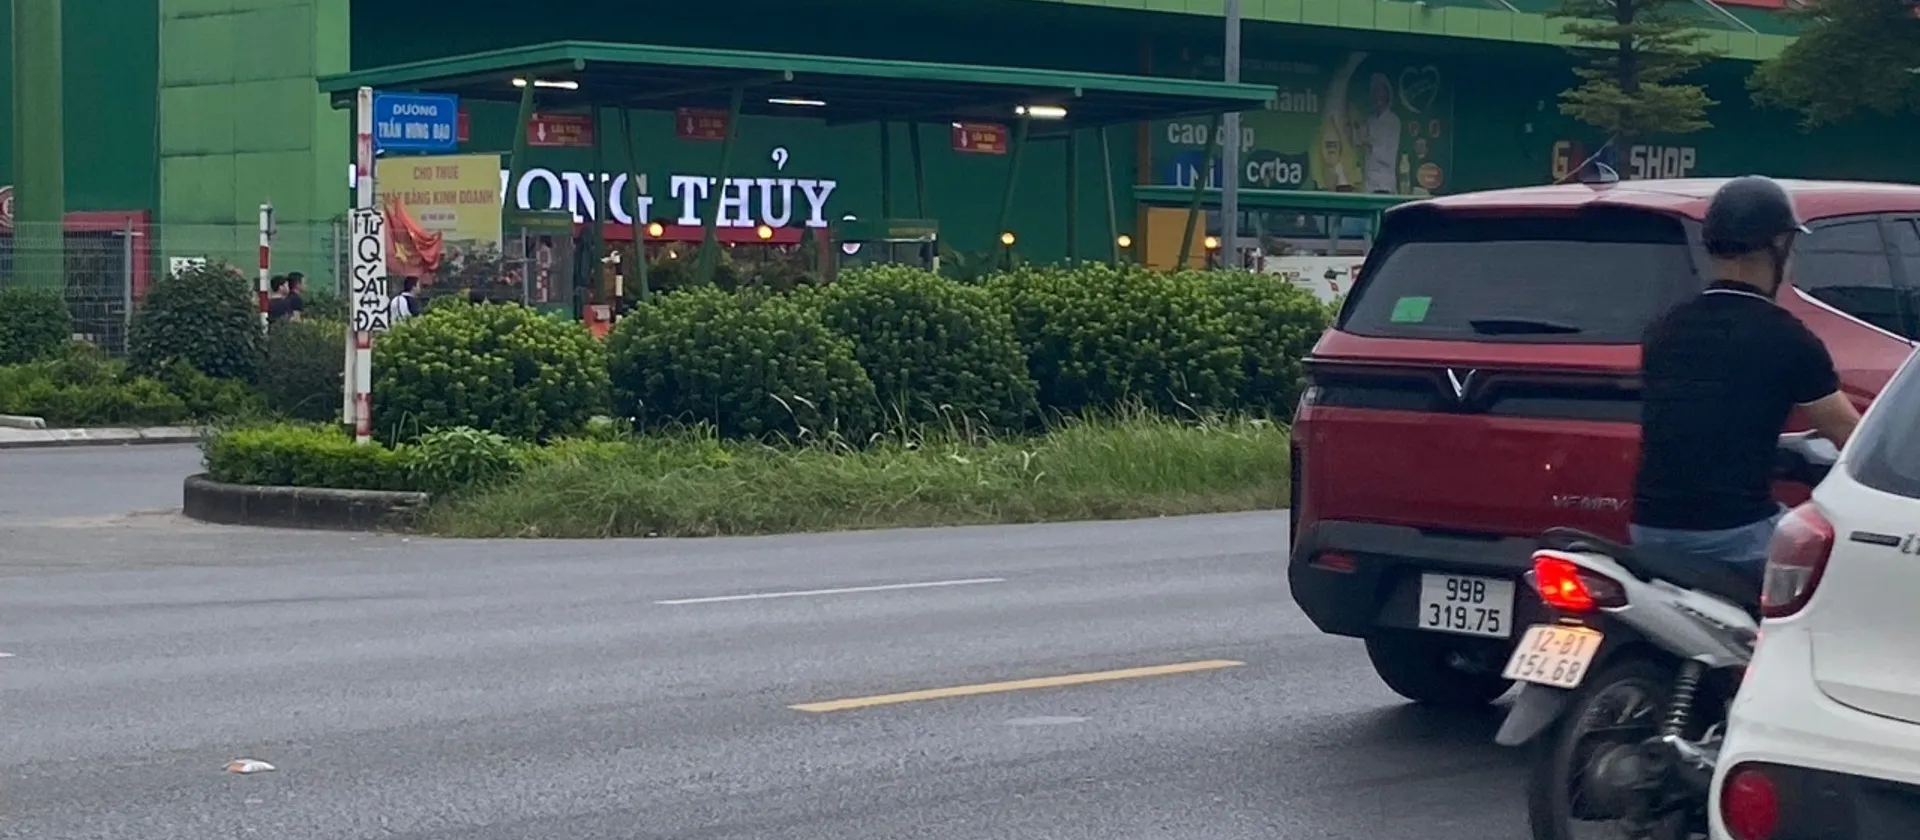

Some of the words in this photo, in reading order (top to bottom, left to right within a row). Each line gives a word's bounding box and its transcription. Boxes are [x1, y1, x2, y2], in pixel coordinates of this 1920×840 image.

[1167, 122, 1208, 145] cao
[1215, 113, 1255, 152] cp
[413, 166, 433, 180] CHO
[1629, 144, 1696, 180] SHOP
[433, 190, 457, 205] KINH
[459, 190, 494, 204] DOANH
[671, 147, 836, 228] THỦY
[353, 265, 389, 296] SÁT
[353, 306, 388, 332] ĐÃ
[1446, 578, 1485, 604] 99B
[1428, 603, 1500, 633] 319.75
[1531, 630, 1587, 657] 12-B1
